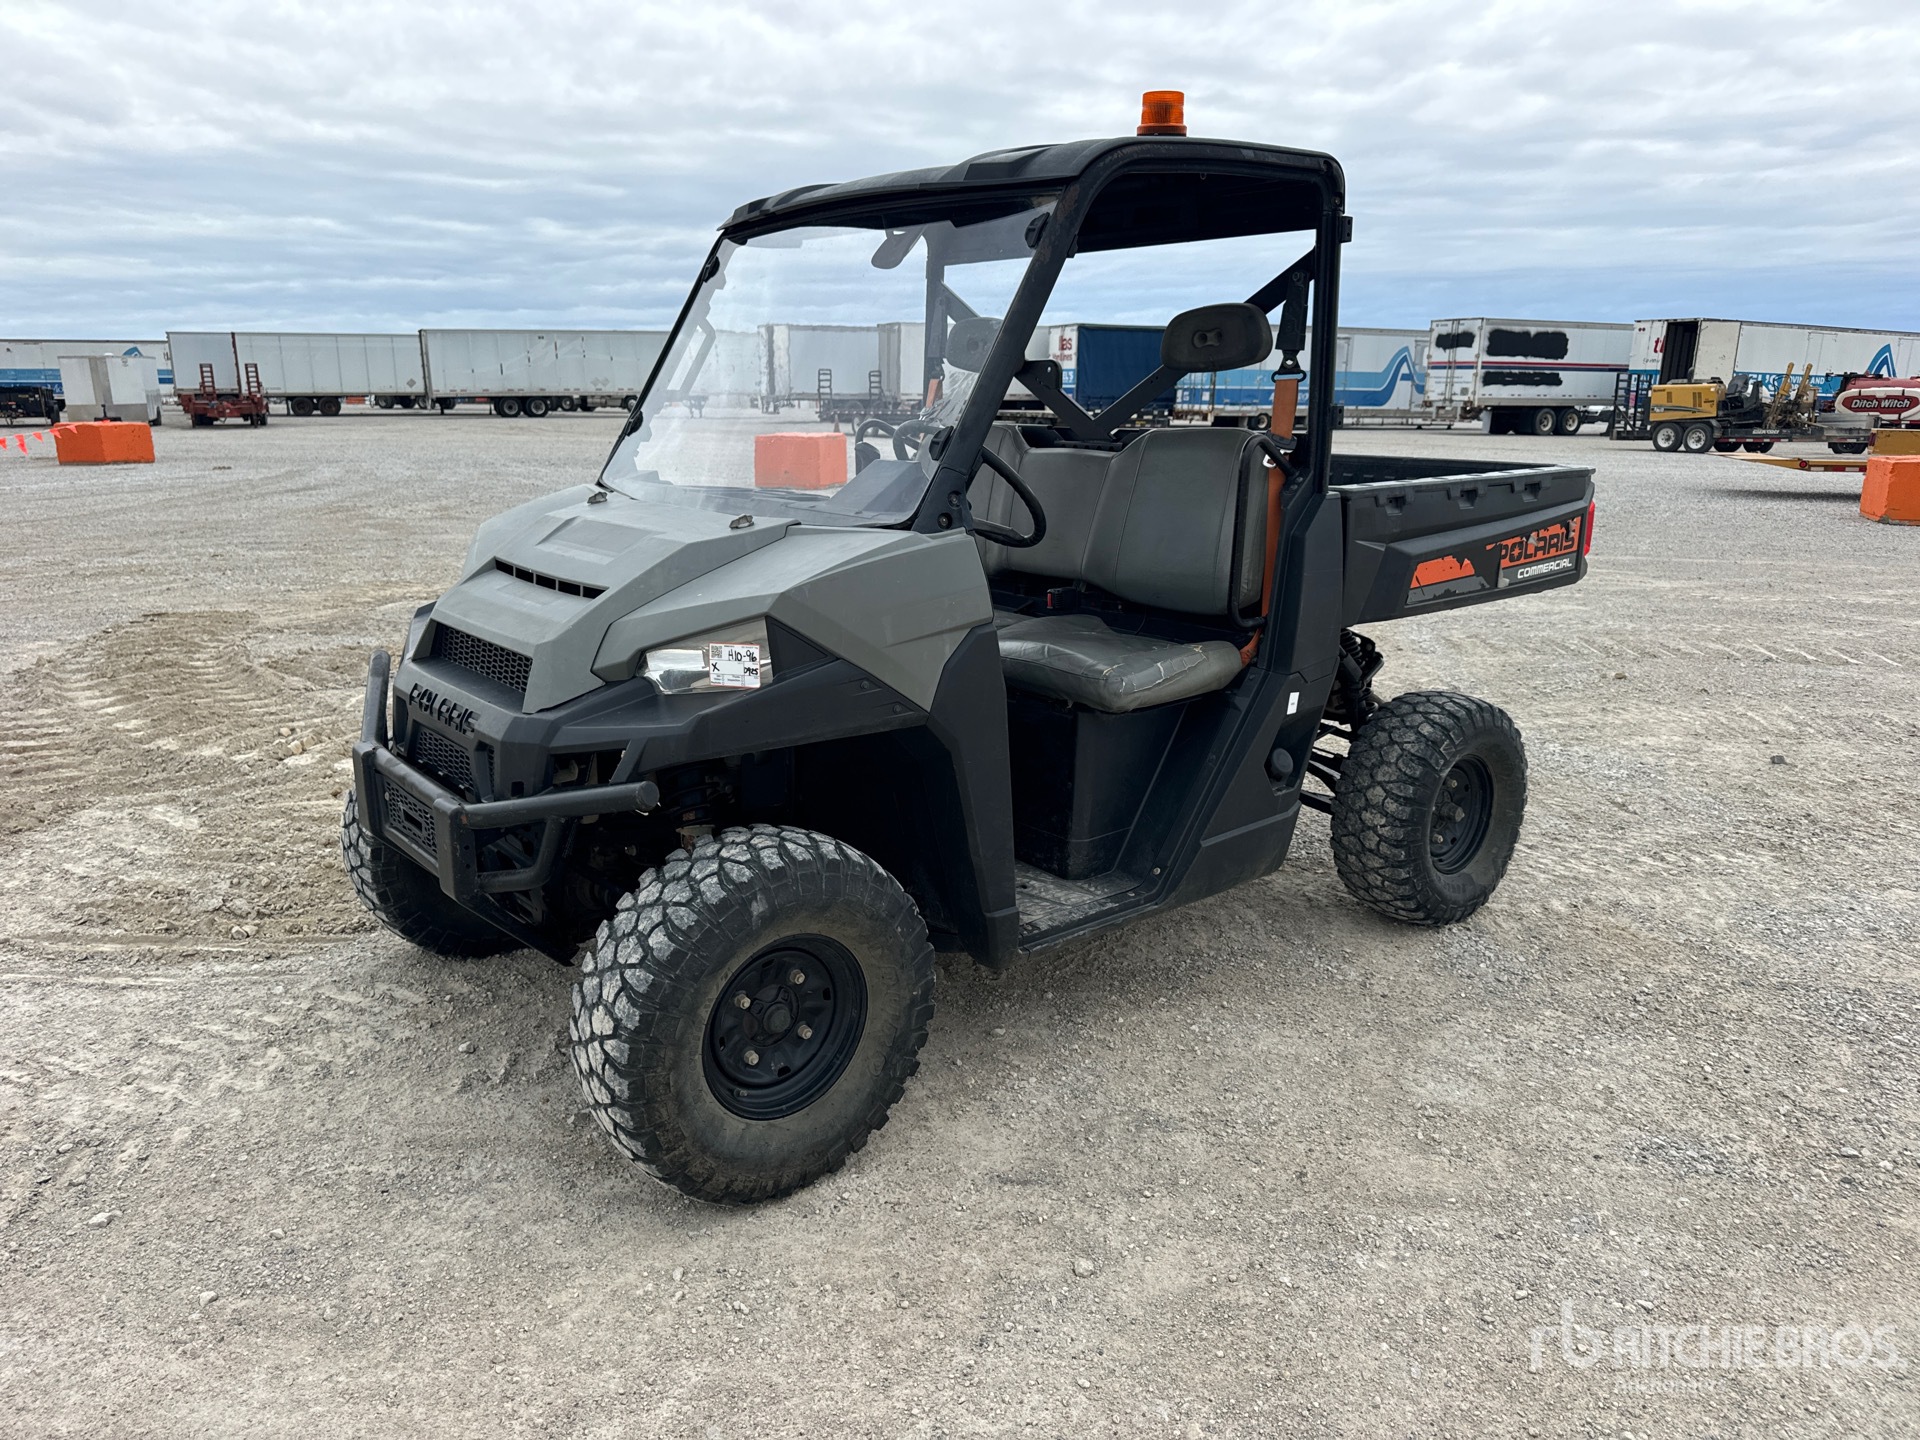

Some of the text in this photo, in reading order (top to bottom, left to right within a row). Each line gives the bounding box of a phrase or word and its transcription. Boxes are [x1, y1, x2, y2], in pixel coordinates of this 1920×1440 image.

[1810, 375, 1825, 385] AND
[1851, 399, 1911, 408] Ditch Witch
[1517, 558, 1573, 579] COMMERCIAL
